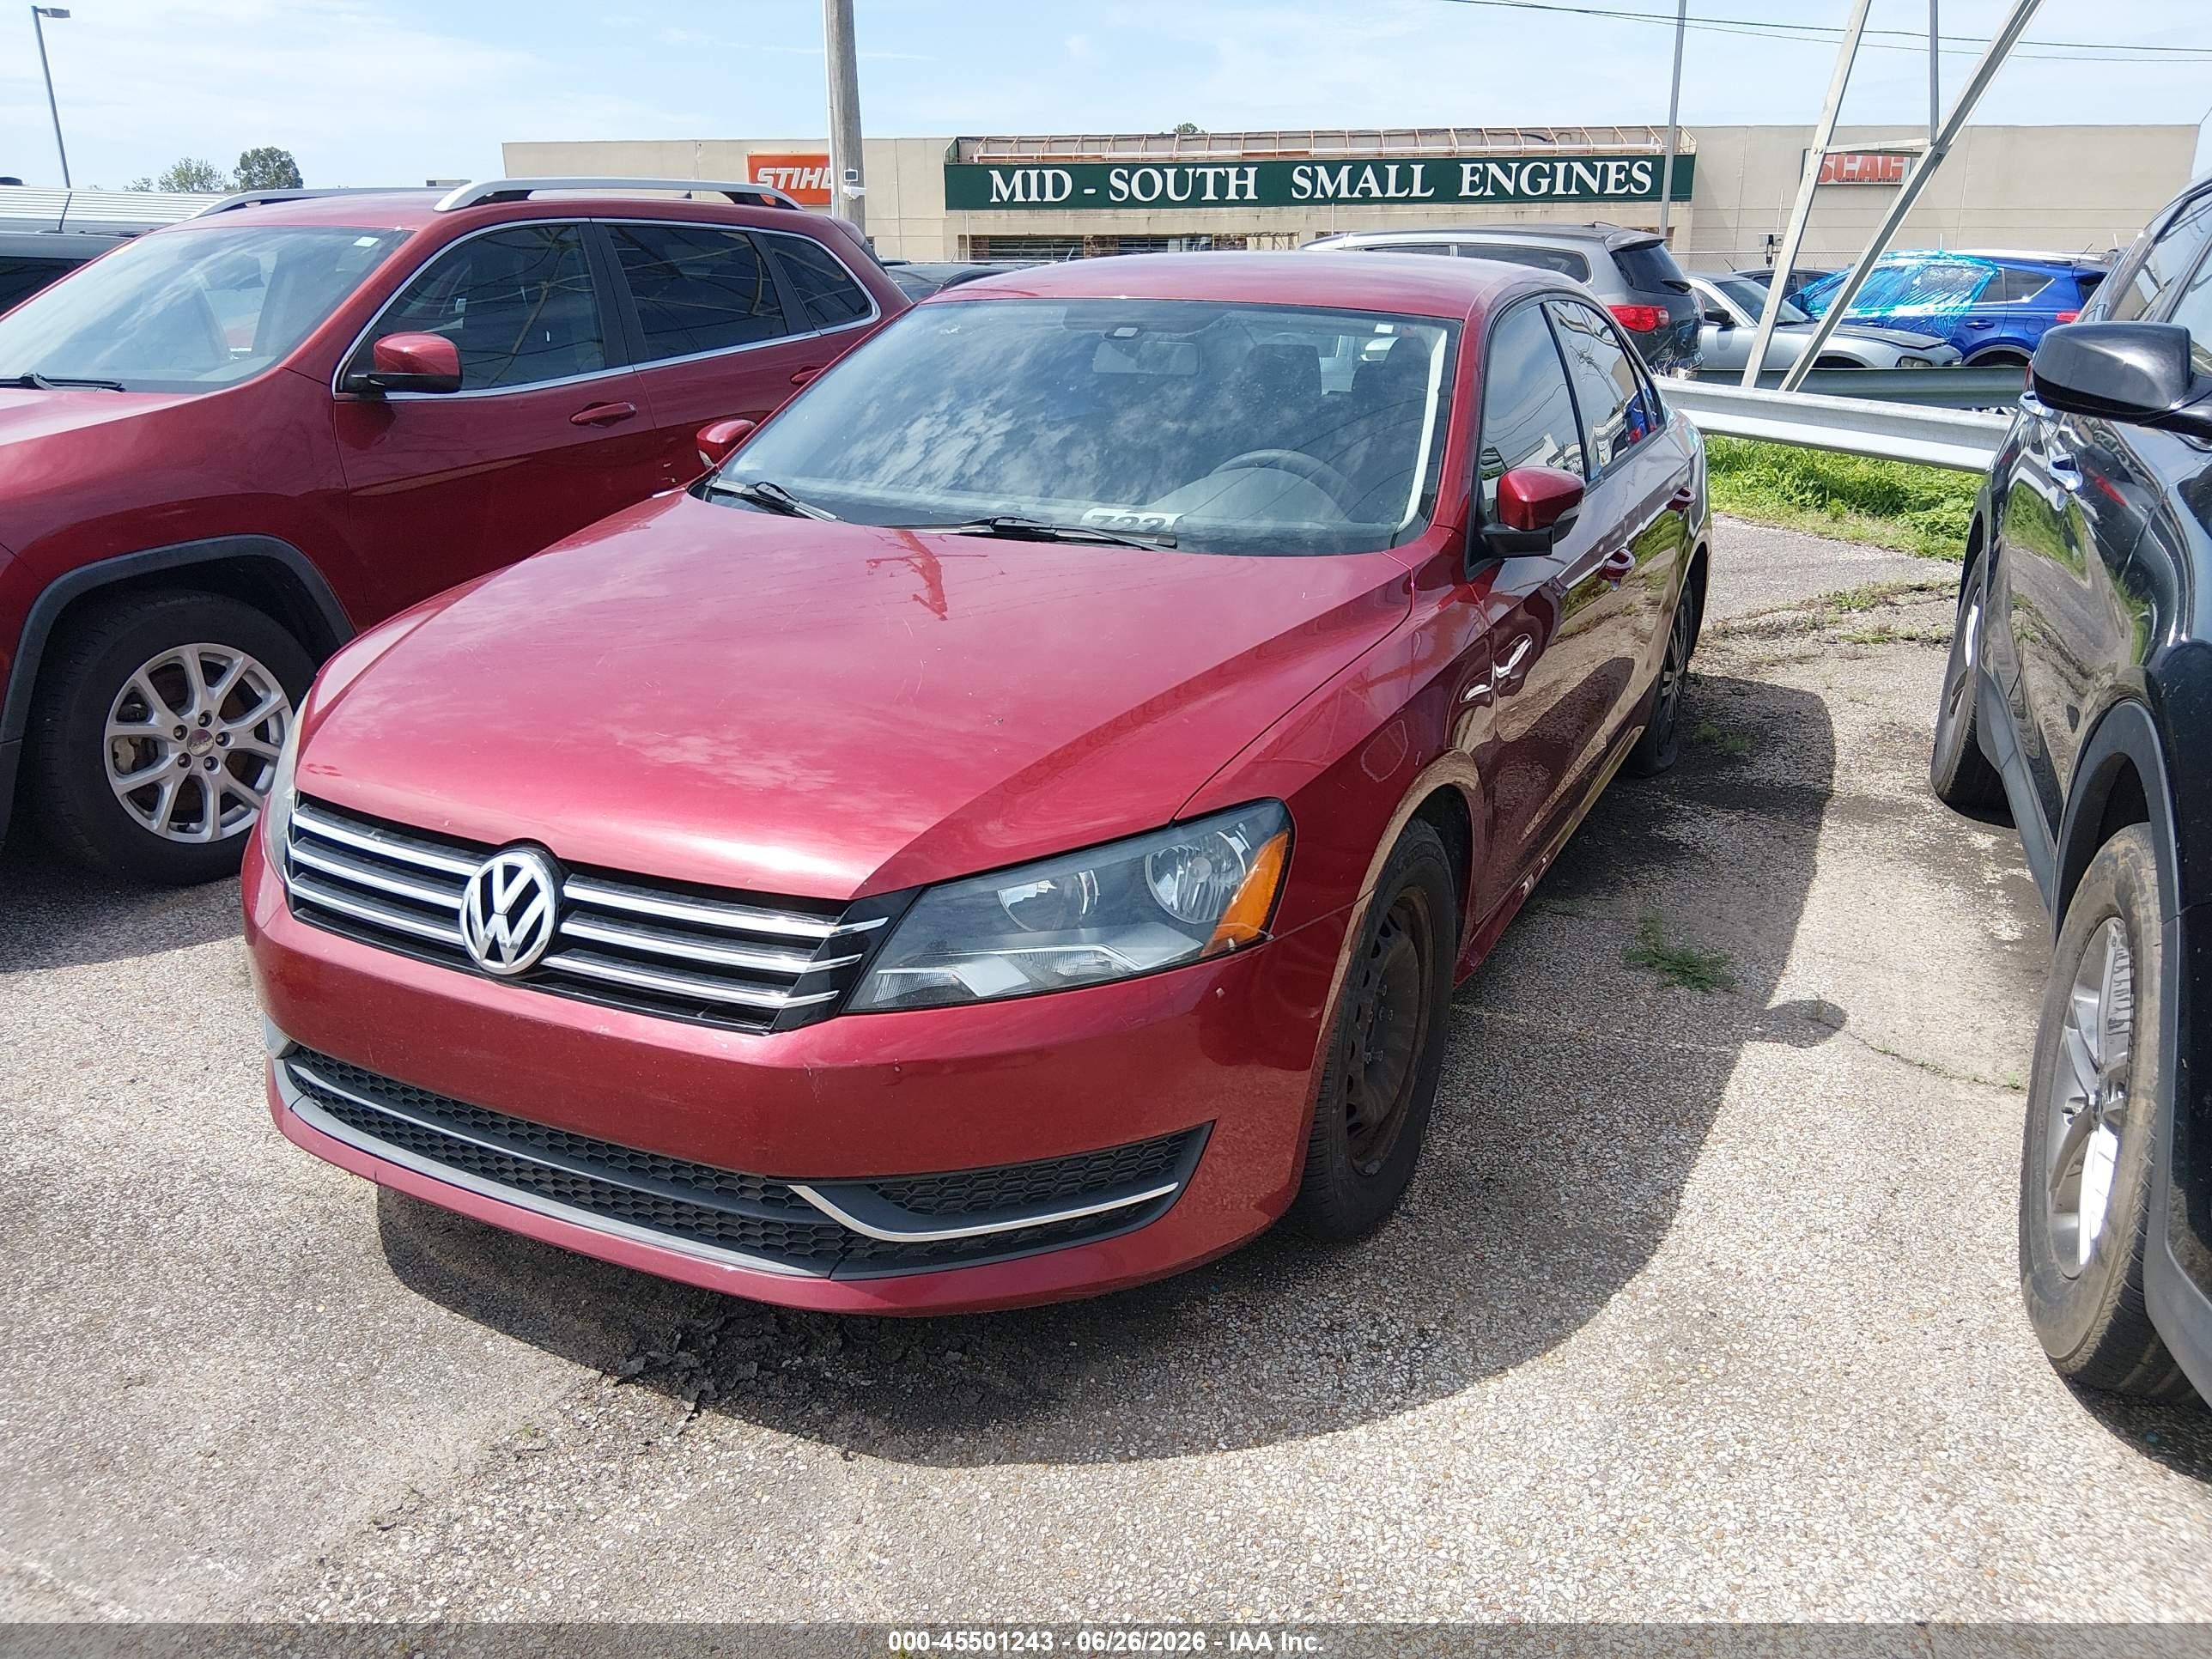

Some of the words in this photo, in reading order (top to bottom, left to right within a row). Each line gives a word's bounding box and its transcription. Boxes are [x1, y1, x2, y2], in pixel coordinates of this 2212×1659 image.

[988, 168, 1073, 203] MID
[1109, 167, 1259, 202] SOUTH
[1291, 163, 1435, 199] SMALL
[1458, 160, 1653, 198] ENGINES
